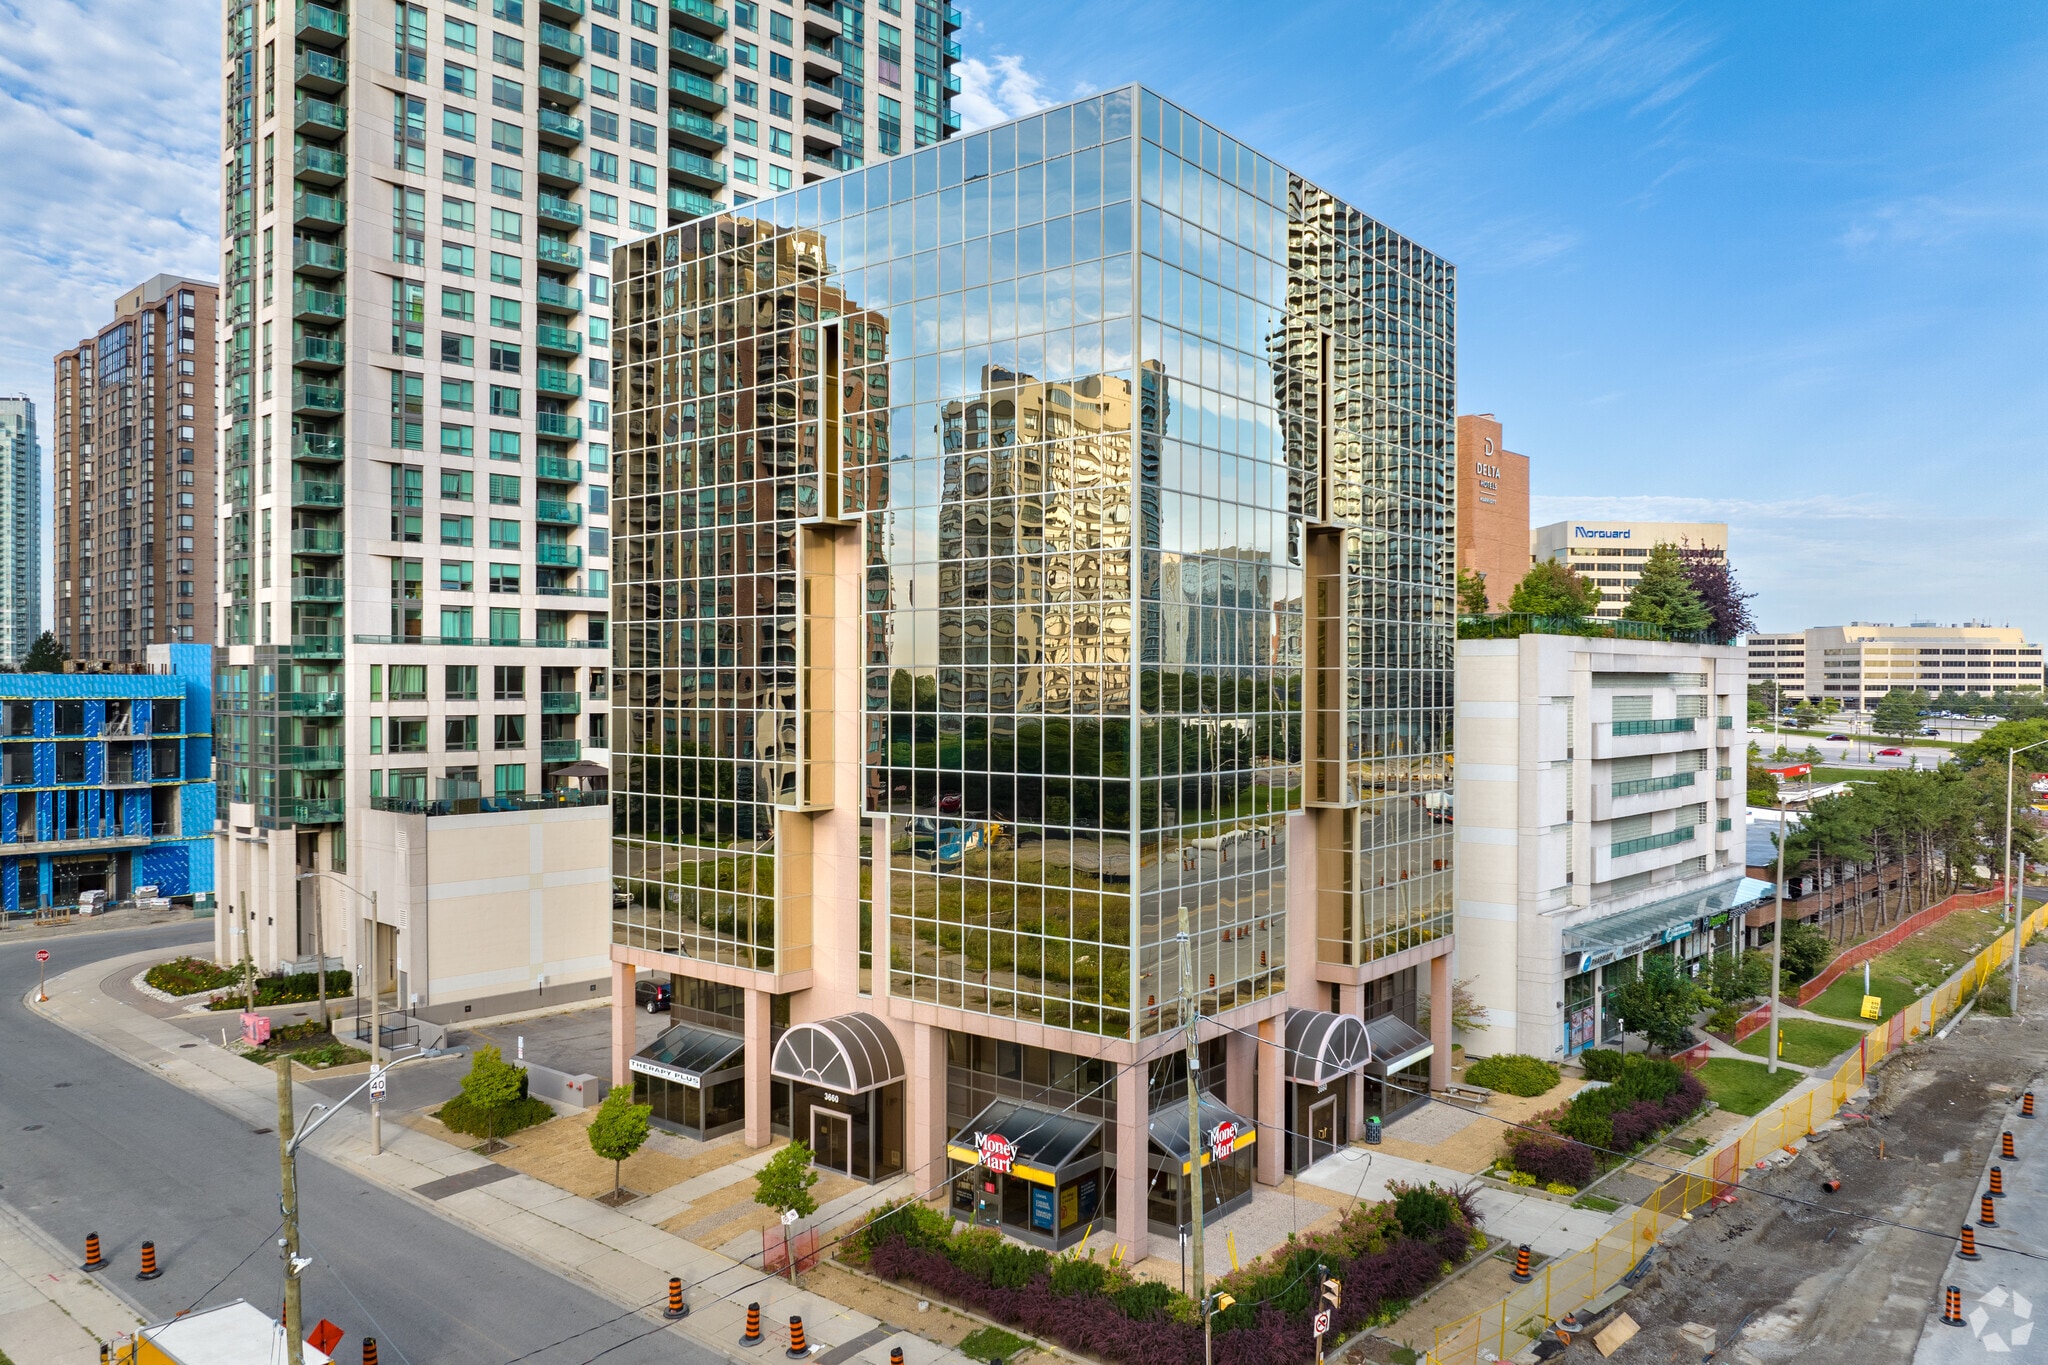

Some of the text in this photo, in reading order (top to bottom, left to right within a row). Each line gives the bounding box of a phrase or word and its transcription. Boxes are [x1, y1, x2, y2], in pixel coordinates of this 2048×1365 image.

[1476, 462, 1501, 479] DELTA
[1575, 526, 1631, 539] Morguard
[631, 1060, 699, 1084] THERAPY PLUS
[371, 1080, 385, 1089] 40
[1207, 1122, 1239, 1147] Money
[974, 1131, 1018, 1162] Money
[1211, 1139, 1235, 1162] Mart
[978, 1149, 1012, 1173] Mart
